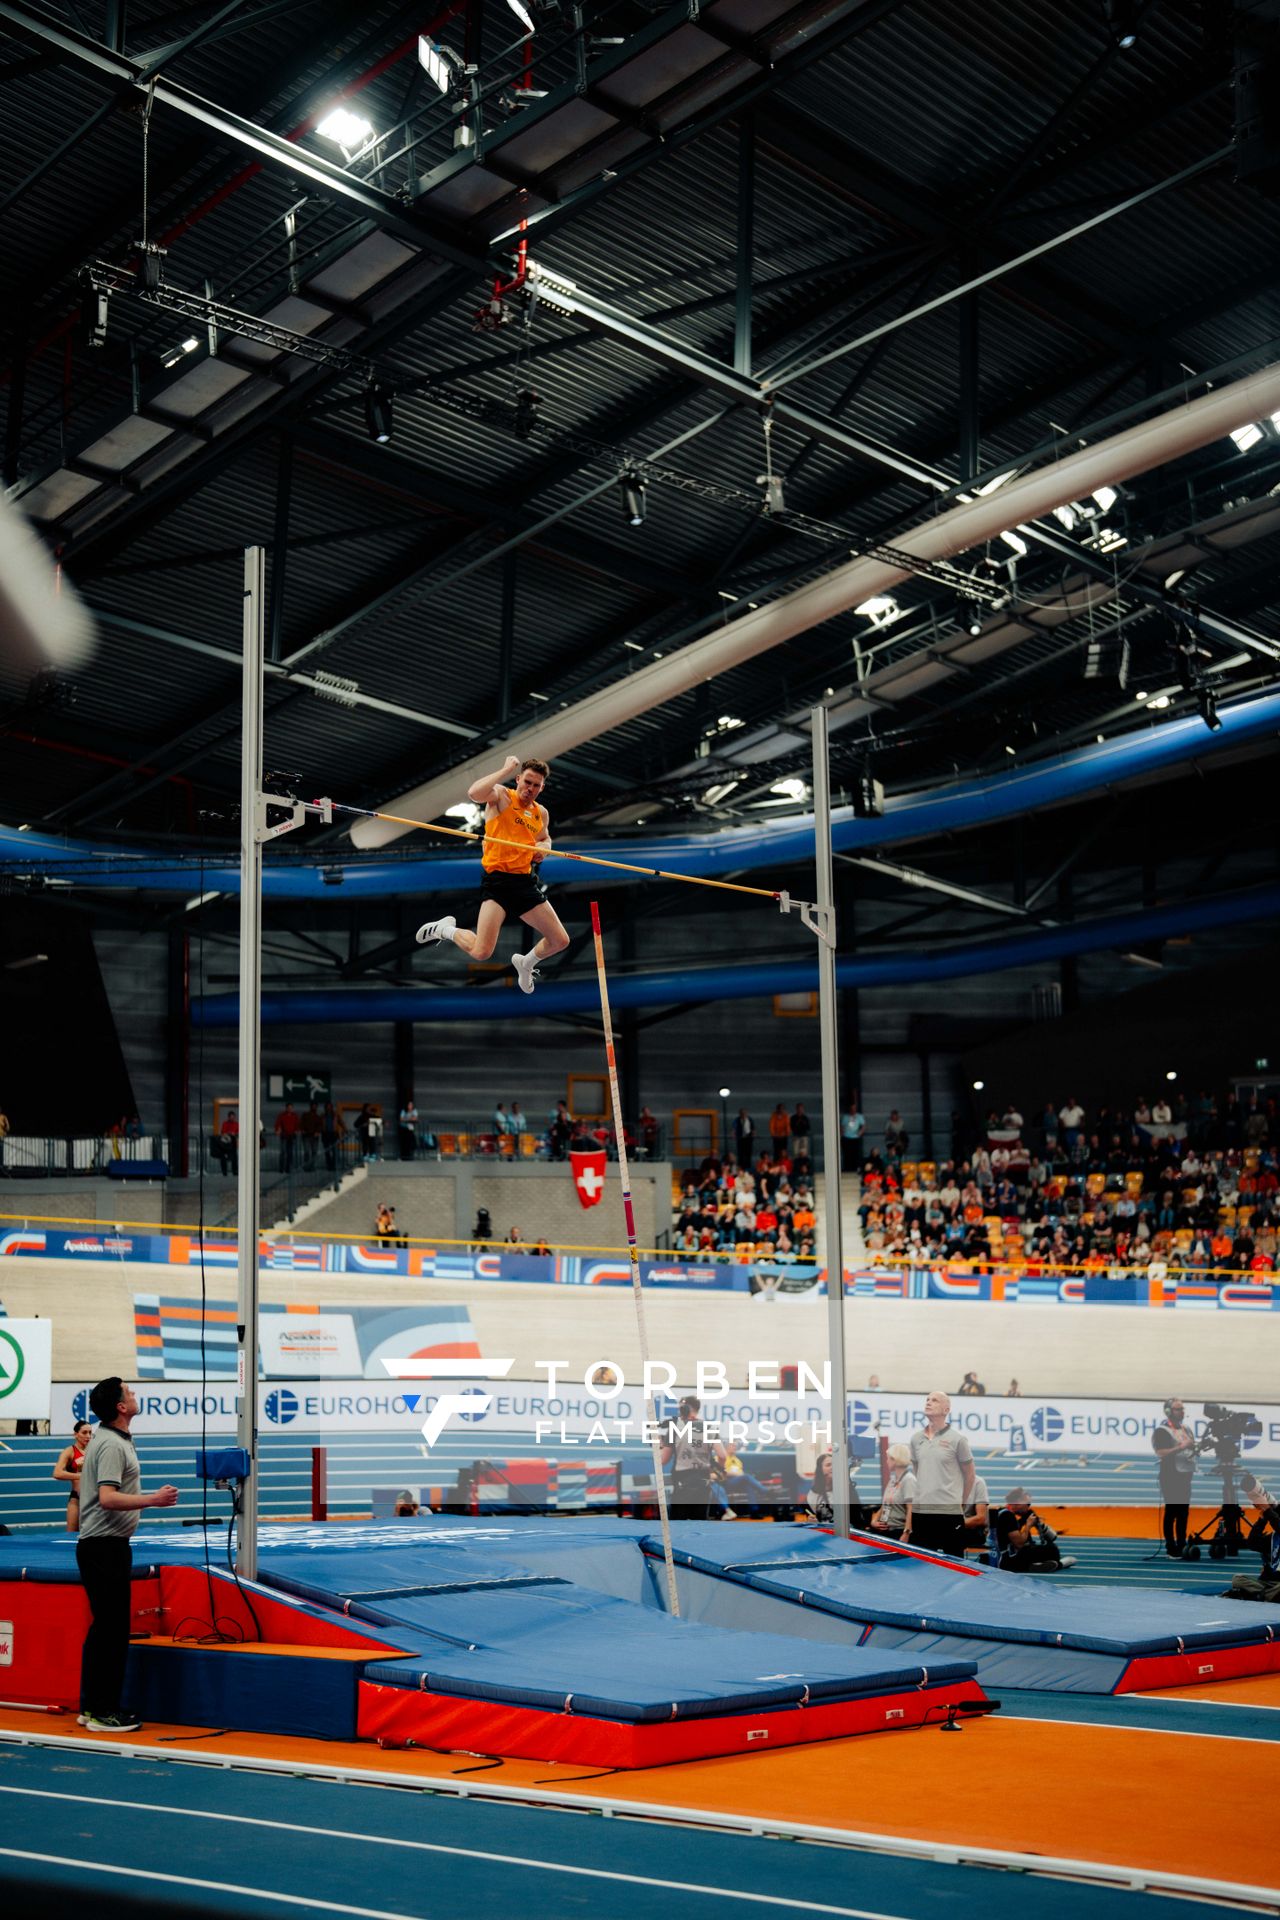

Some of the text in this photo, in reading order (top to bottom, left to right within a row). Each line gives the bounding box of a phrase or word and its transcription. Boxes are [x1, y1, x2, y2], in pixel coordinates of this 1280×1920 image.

[497, 1397, 632, 1419] EUROHOLD
[703, 1404, 822, 1425] UROHOLD
[878, 1409, 1014, 1432] EURHOLD
[1071, 1416, 1208, 1438] EUROHD
[1012, 1429, 1024, 1445] 6
